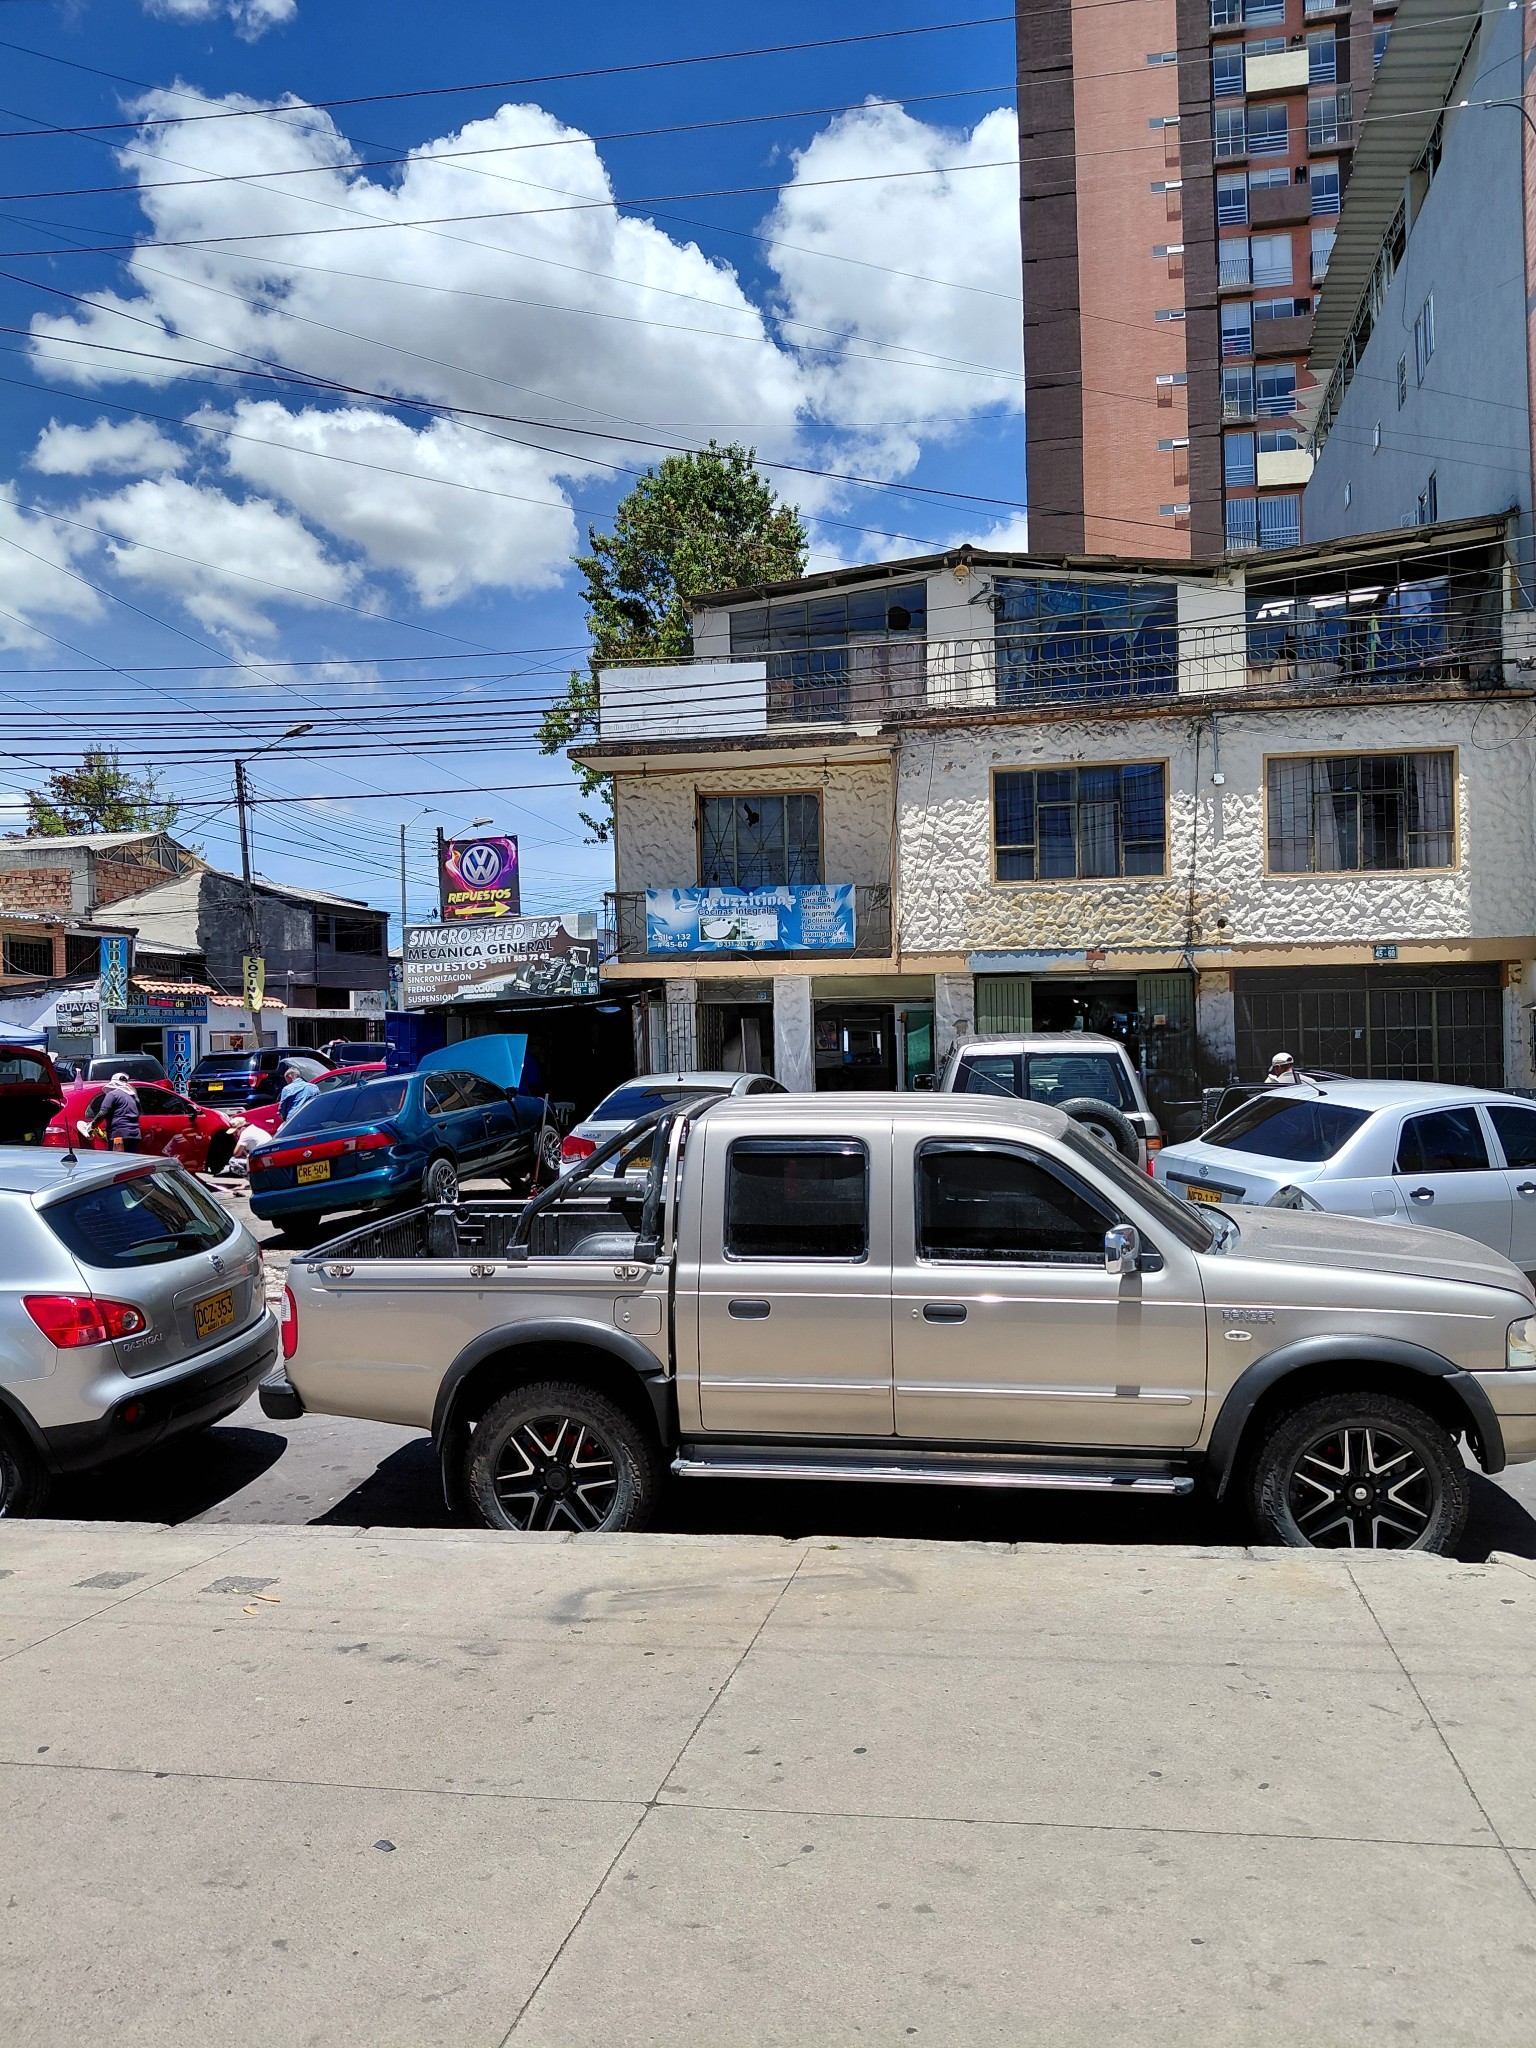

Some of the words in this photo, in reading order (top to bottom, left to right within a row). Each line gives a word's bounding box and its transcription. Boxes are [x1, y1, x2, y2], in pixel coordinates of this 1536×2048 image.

[448, 888, 511, 904] REPUESTOS
[698, 908, 733, 916] Cocinas
[735, 906, 779, 916] Integrales
[408, 929, 471, 948] SINCRO
[474, 922, 525, 943] SPEED
[529, 919, 563, 939] 132
[652, 933, 673, 941] Calle
[676, 933, 691, 941] 132
[408, 945, 483, 961] MECANICA
[487, 939, 554, 955] GENERAL
[529, 953, 539, 961] 72
[540, 952, 549, 960] 42
[108, 939, 121, 1007] GUAYAS
[407, 960, 487, 974] REPUESTOS
[246, 957, 259, 1008] COCINAS
[407, 973, 472, 984] SINCRONIZACIÓN
[407, 985, 436, 994] FRENOS
[175, 1000, 185, 1008] de
[408, 992, 455, 1004] SUSPENSIÓN
[56, 1002, 98, 1013] GUAYAS
[61, 1025, 97, 1034] FABRICANTES
[173, 1033, 187, 1093] GUAYAS
[1221, 1309, 1276, 1325] RANGER
